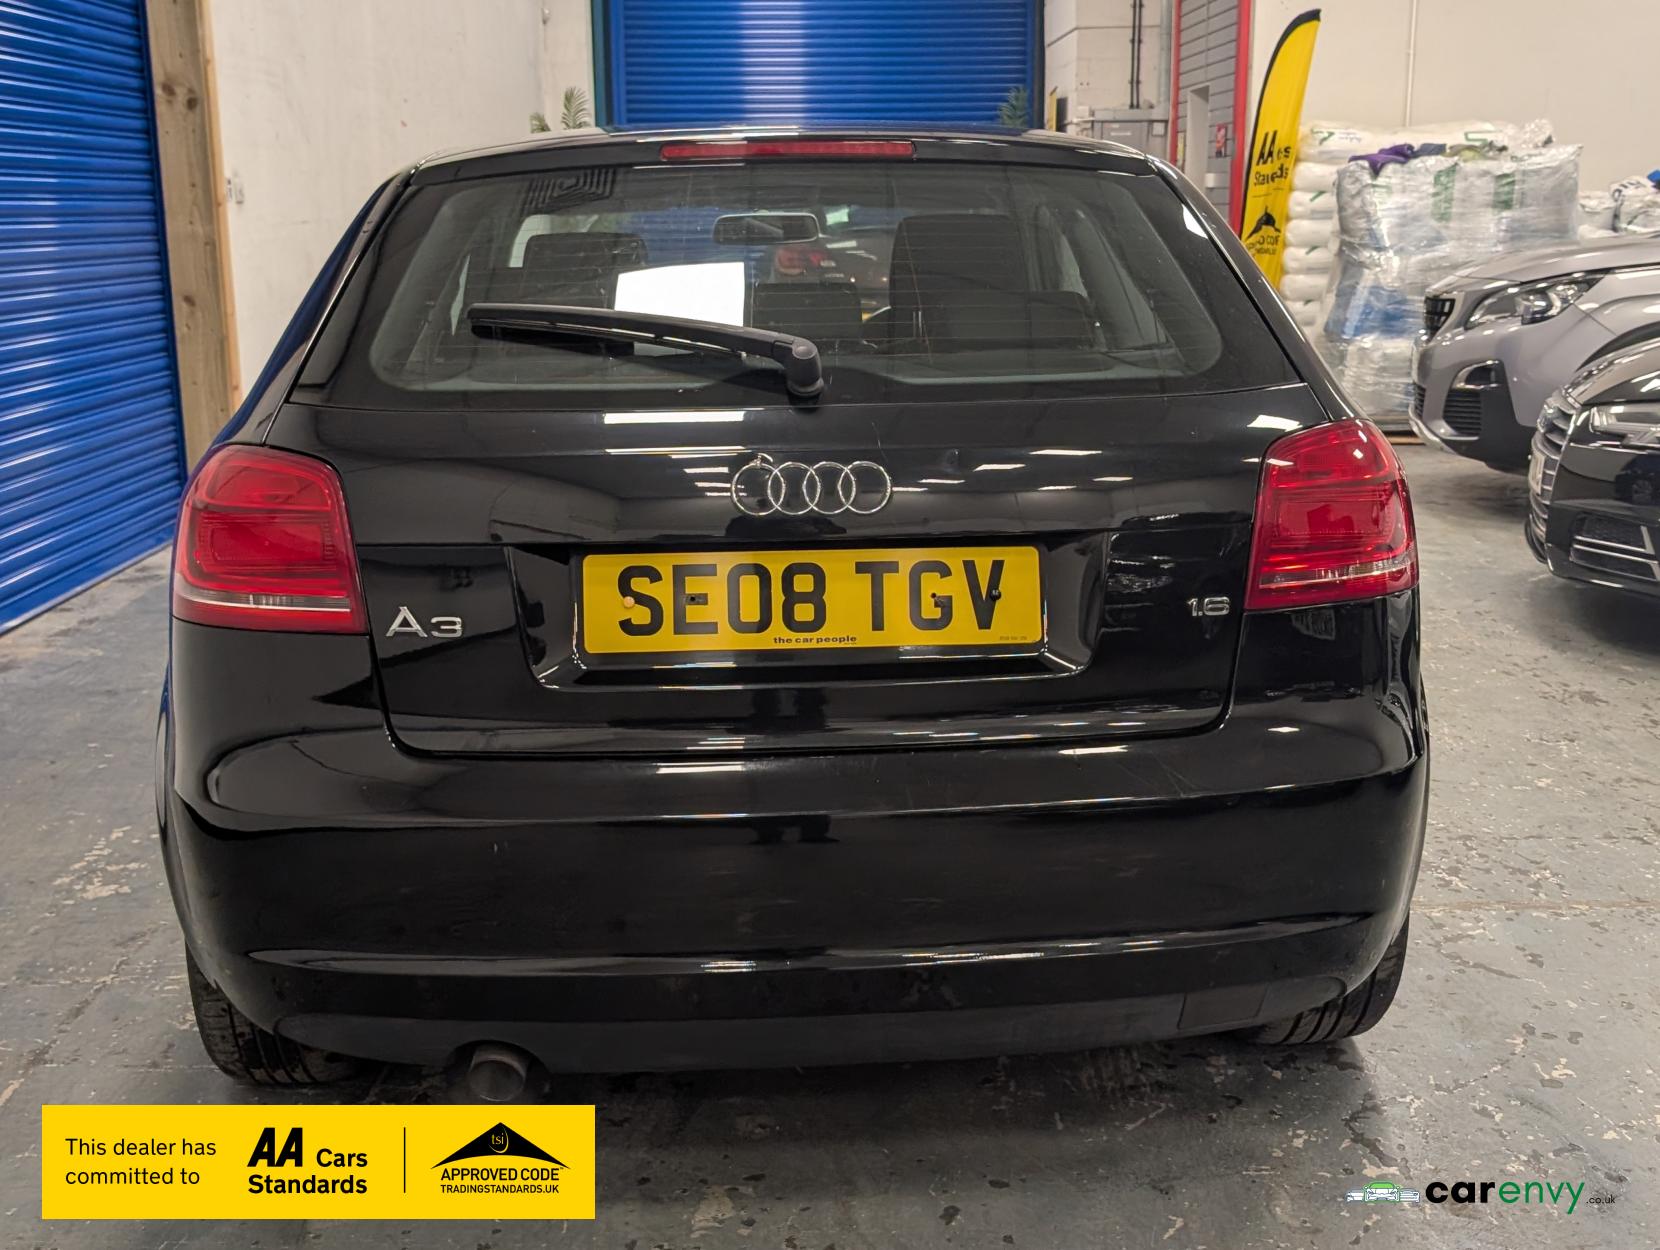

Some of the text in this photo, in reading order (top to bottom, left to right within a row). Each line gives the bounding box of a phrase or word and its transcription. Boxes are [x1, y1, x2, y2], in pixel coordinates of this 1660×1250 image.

[617, 559, 1005, 637] SE08 TGV
[1186, 596, 1230, 617] 1.6
[385, 606, 463, 638] A3
[816, 635, 857, 644] people
